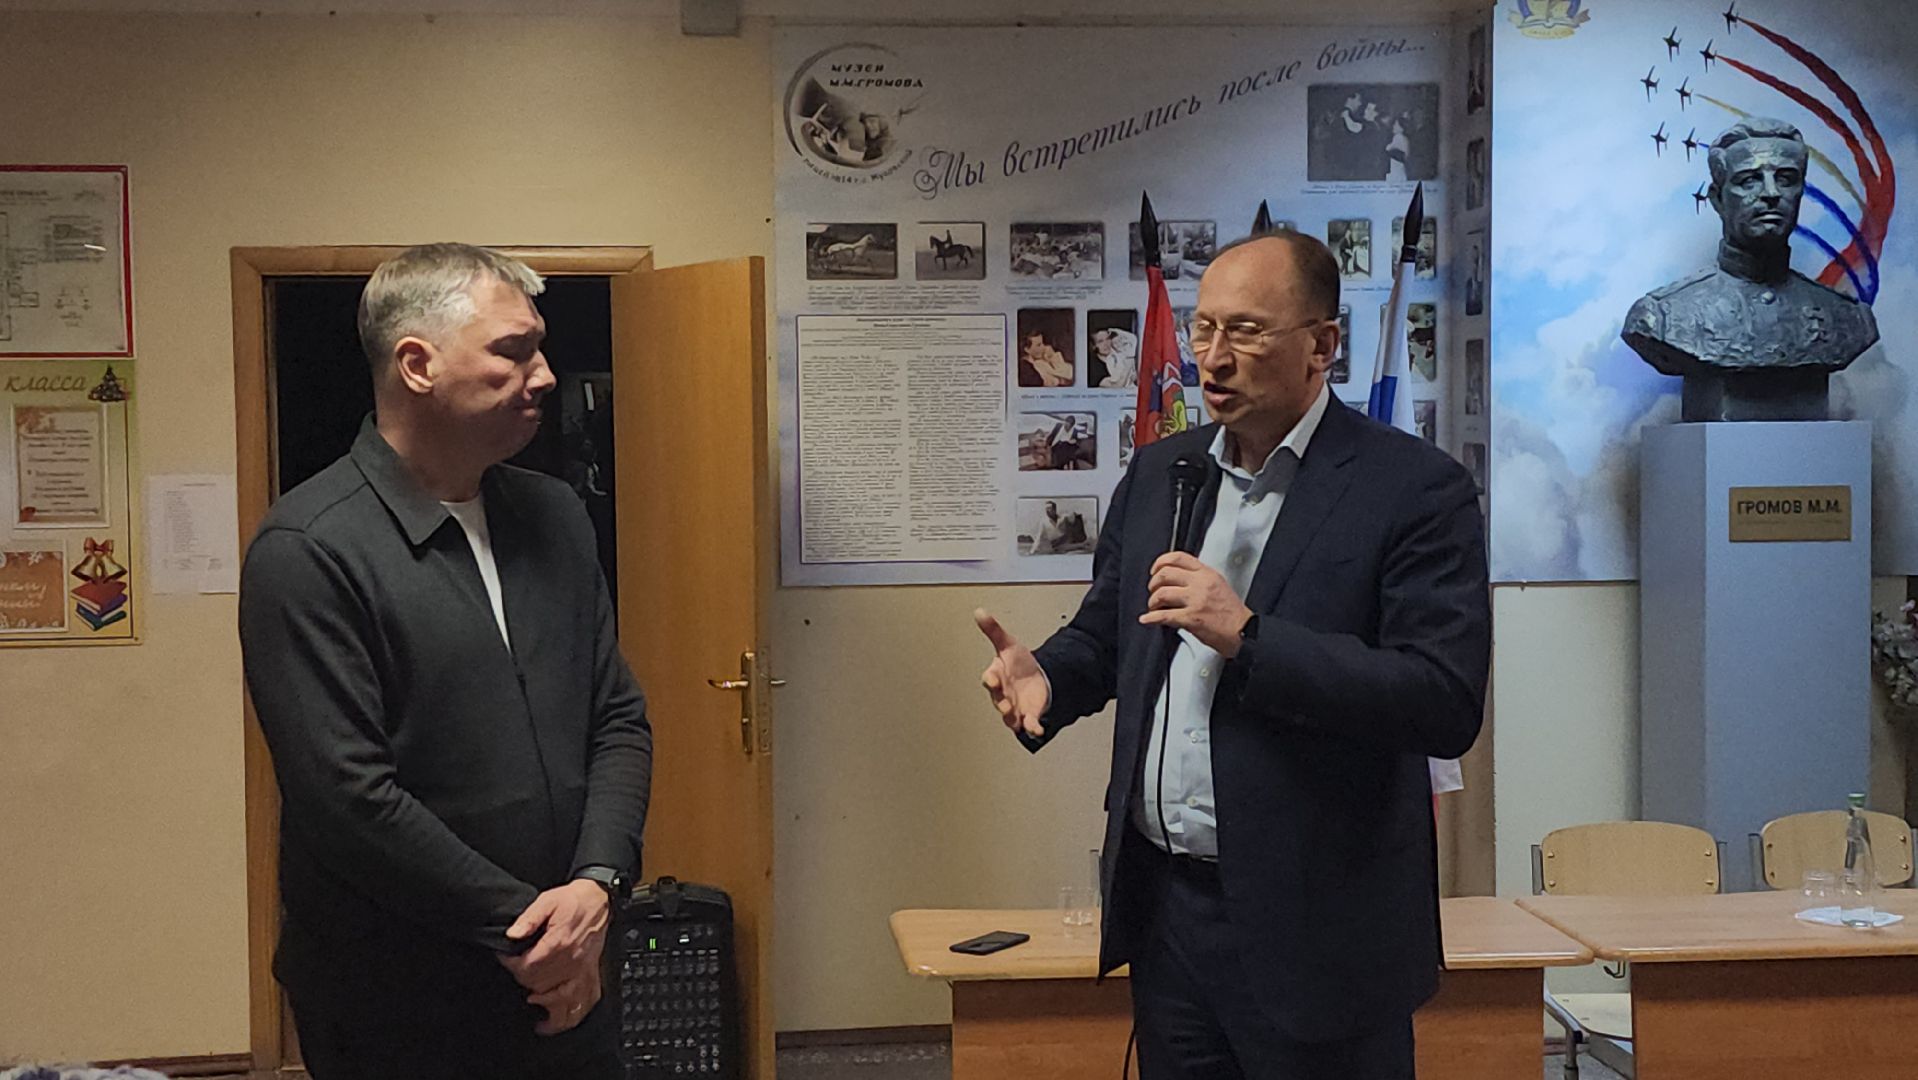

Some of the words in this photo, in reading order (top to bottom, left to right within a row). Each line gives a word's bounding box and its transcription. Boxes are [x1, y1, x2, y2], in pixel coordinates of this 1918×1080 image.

[914, 148, 984, 200] Мы
[1003, 96, 1201, 177] встретились
[1219, 60, 1302, 104] после
[1316, 38, 1426, 71] войны...
[3, 375, 88, 393] класса
[1736, 499, 1803, 515] ГРОМОВ
[1808, 499, 1843, 514] М.М.
